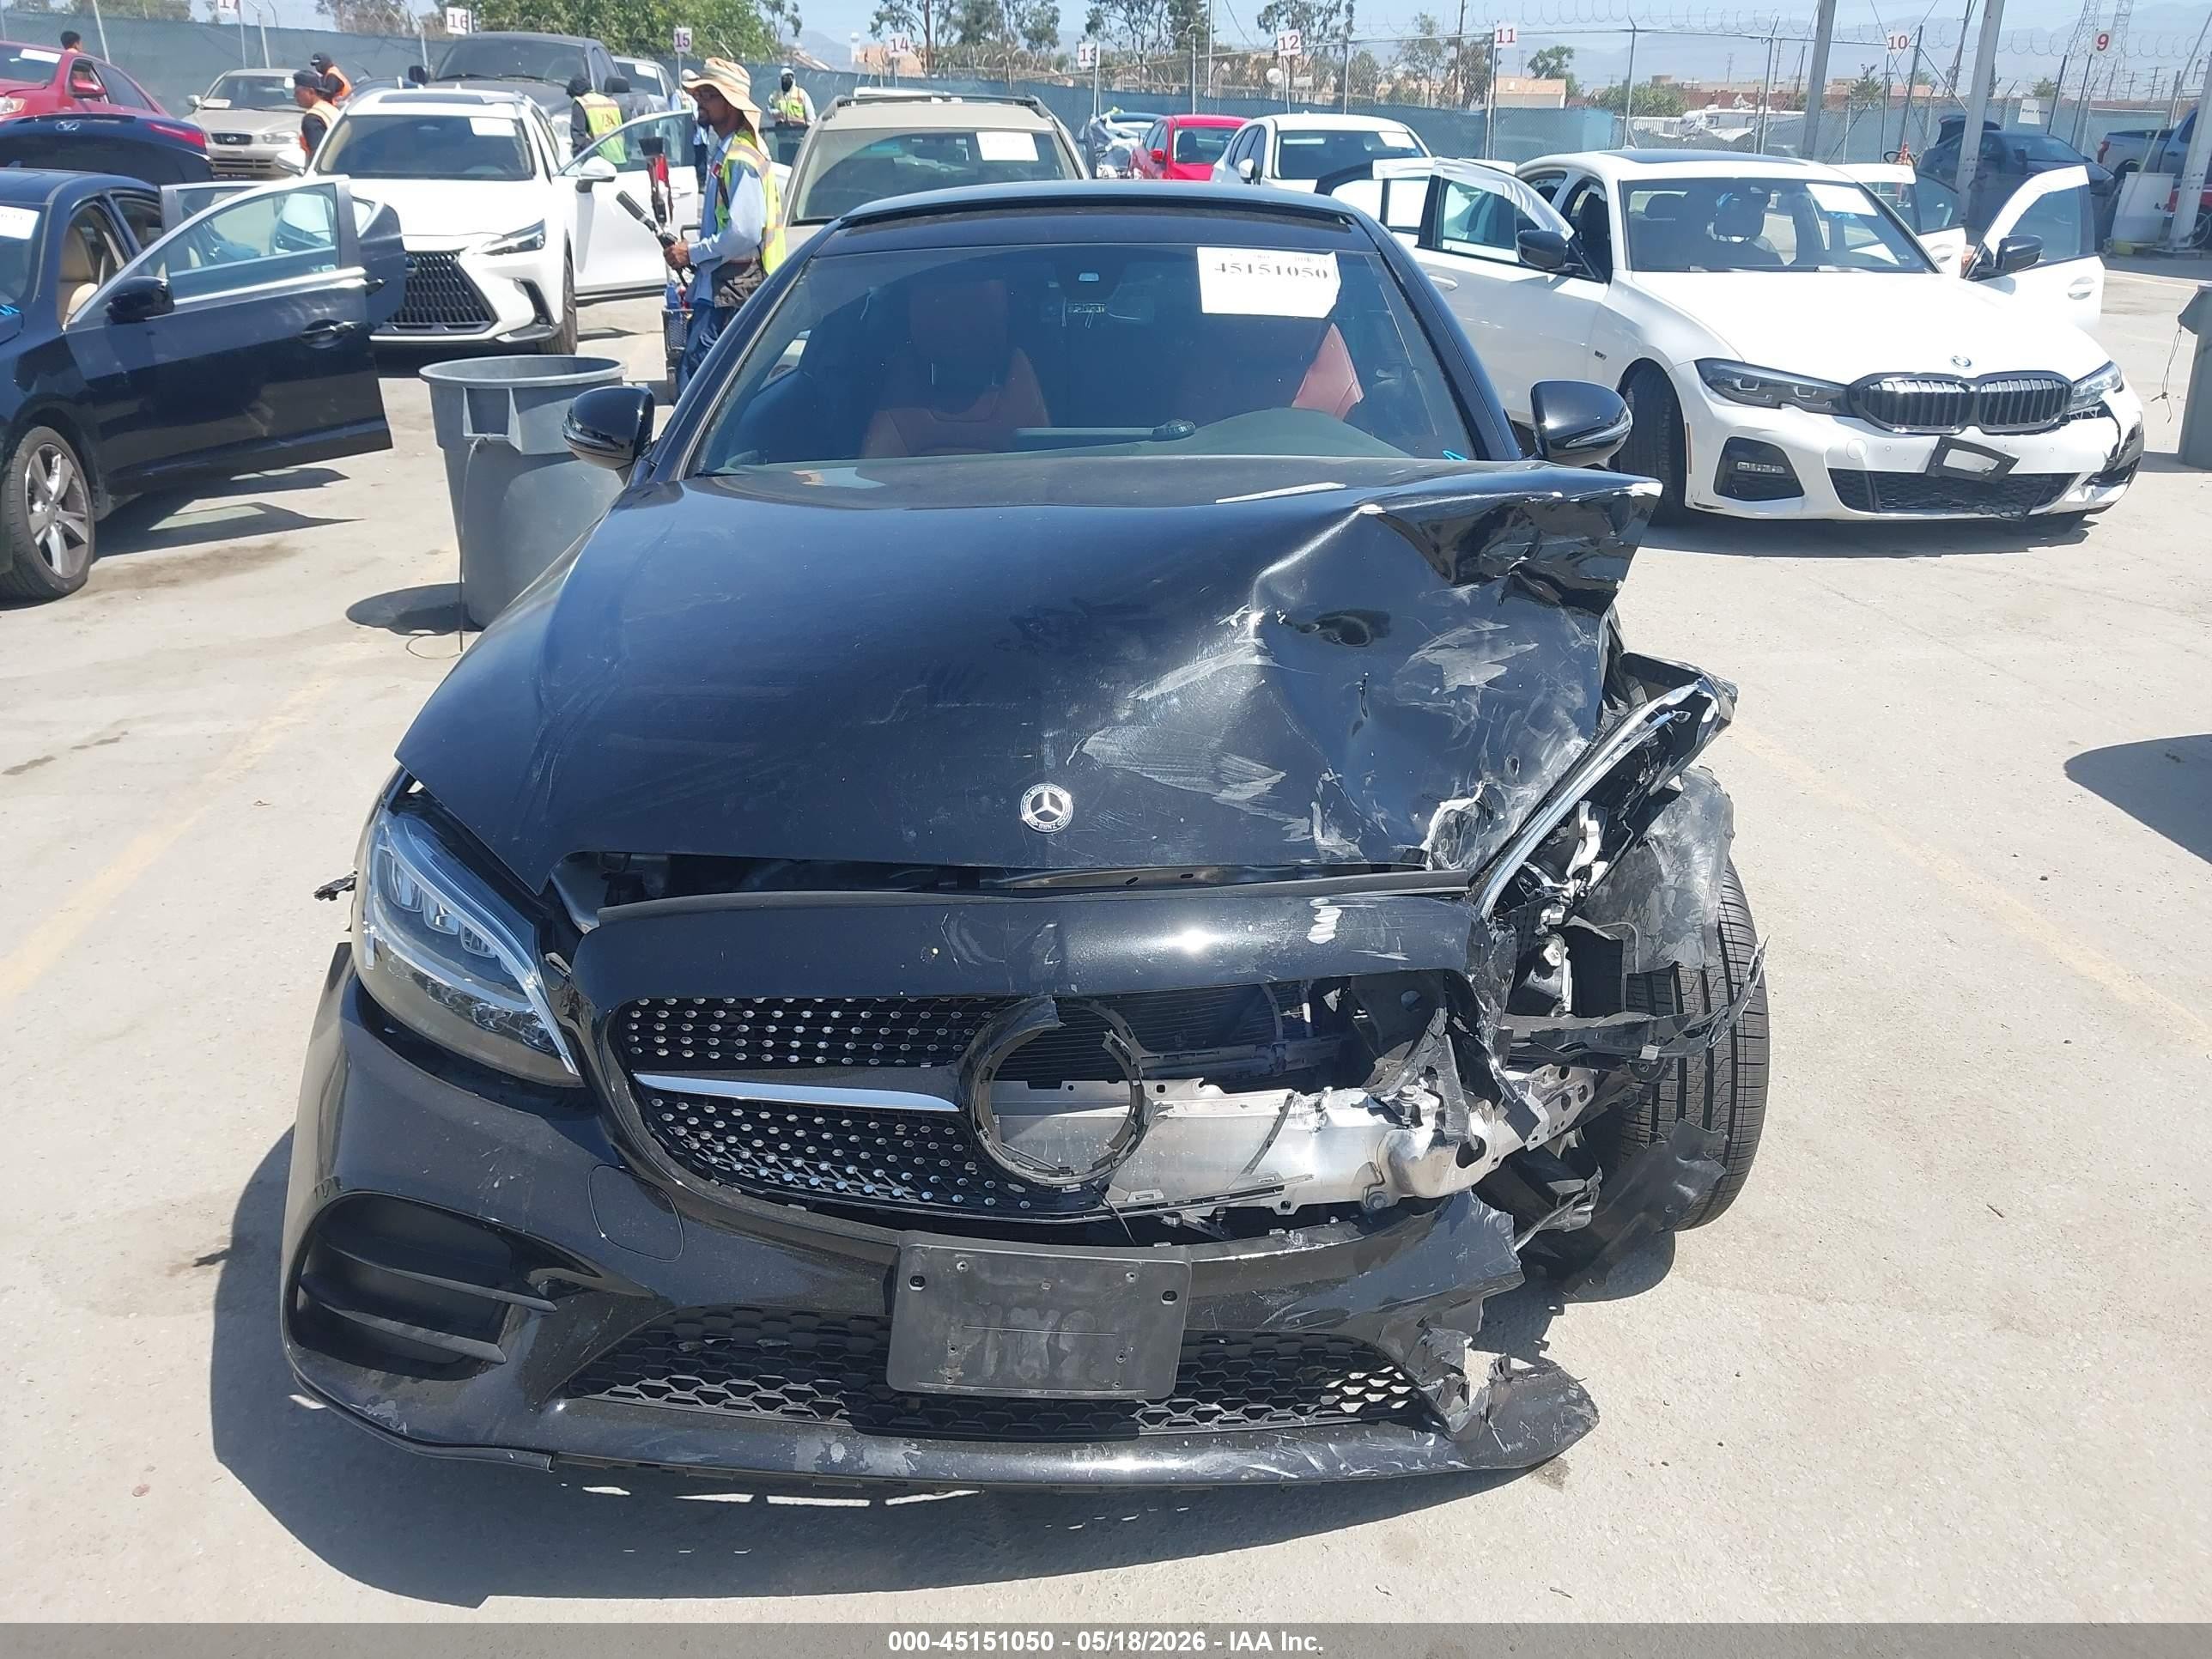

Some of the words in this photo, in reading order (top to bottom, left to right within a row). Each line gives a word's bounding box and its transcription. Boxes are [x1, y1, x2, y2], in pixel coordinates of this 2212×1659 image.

[675, 33, 691, 48] 15
[1279, 34, 1300, 52] 12
[1497, 27, 1516, 44] 11
[1887, 34, 1909, 50] 10
[2096, 33, 2110, 52] 9
[890, 37, 909, 53] 14
[1079, 47, 1097, 63] 13
[1214, 263, 1328, 279] 45151050
